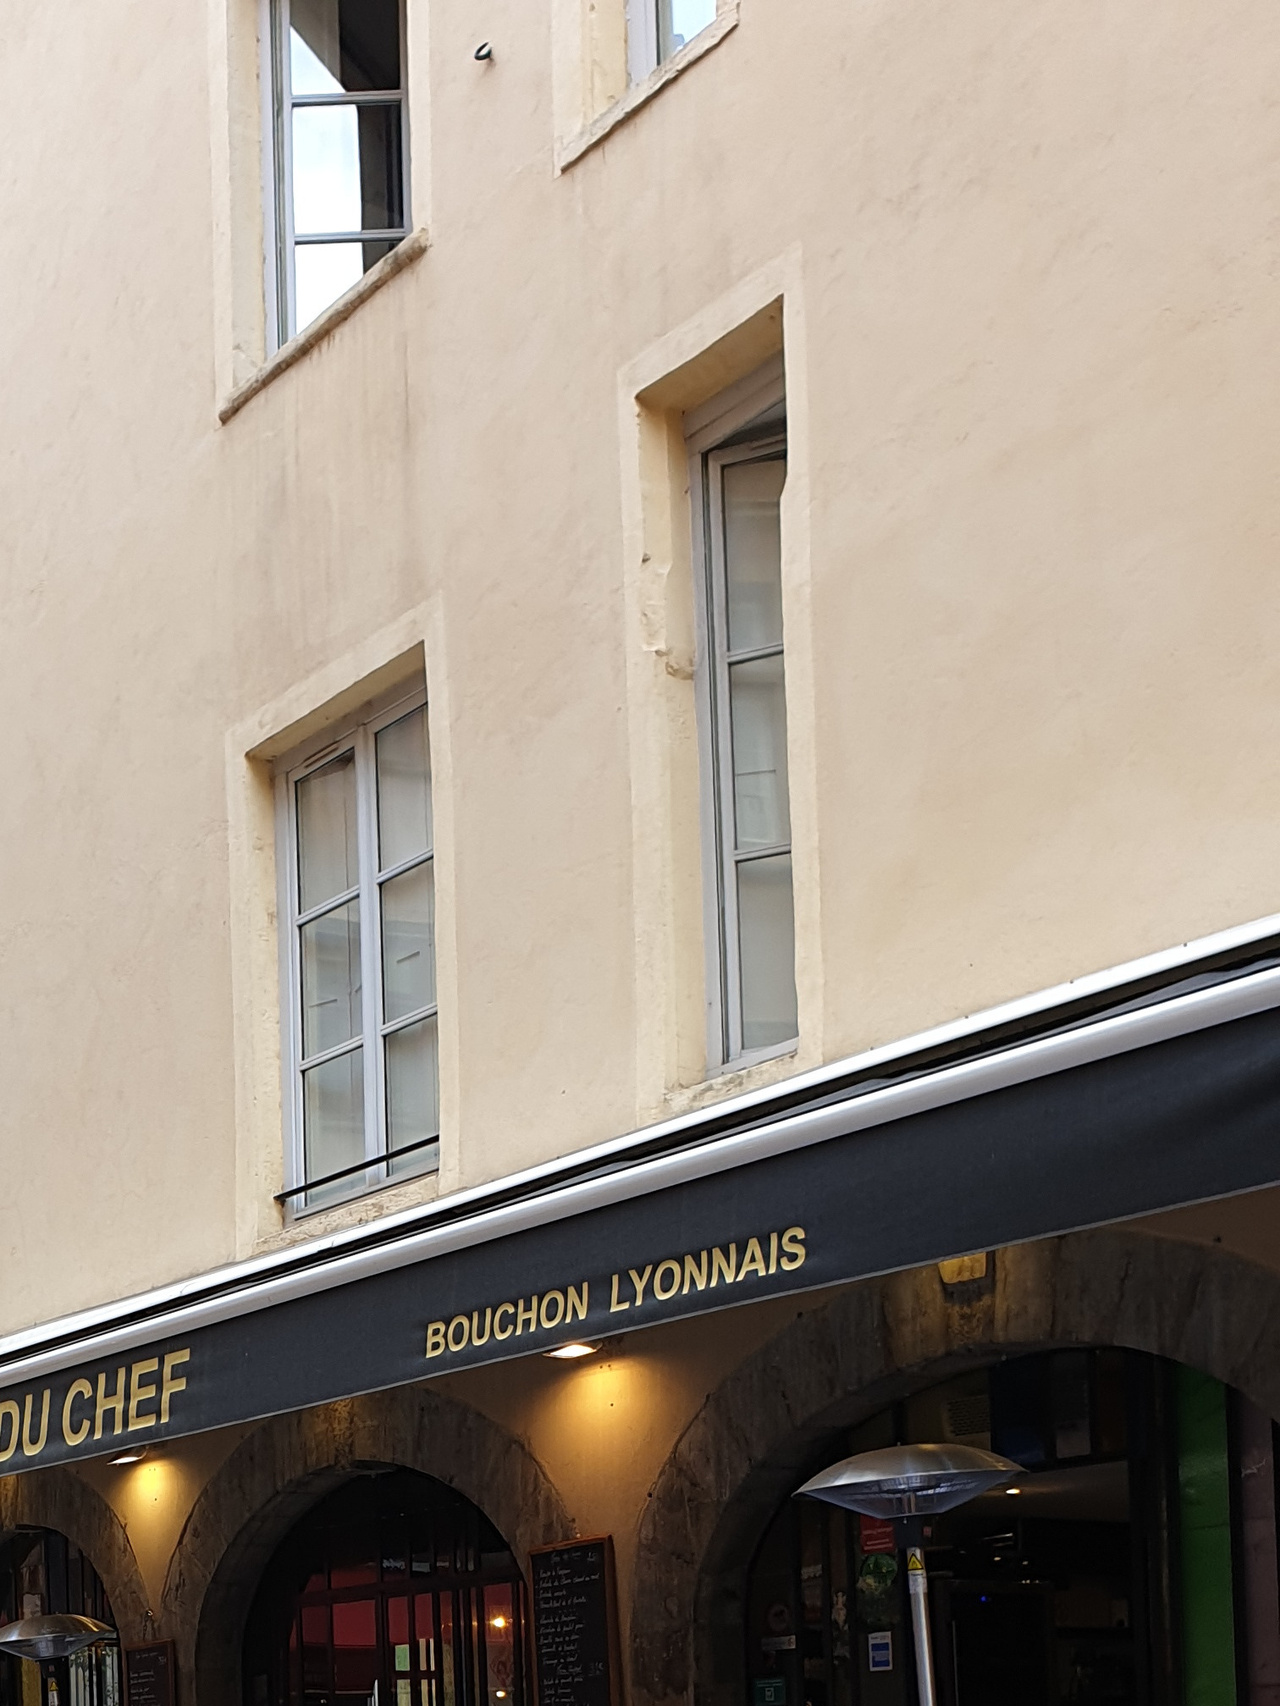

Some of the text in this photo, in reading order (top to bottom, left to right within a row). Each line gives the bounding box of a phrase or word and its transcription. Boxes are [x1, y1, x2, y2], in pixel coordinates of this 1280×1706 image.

[425, 1226, 807, 1358] BOUCHON LYONNAIS
[62, 1348, 192, 1447] CHEF
